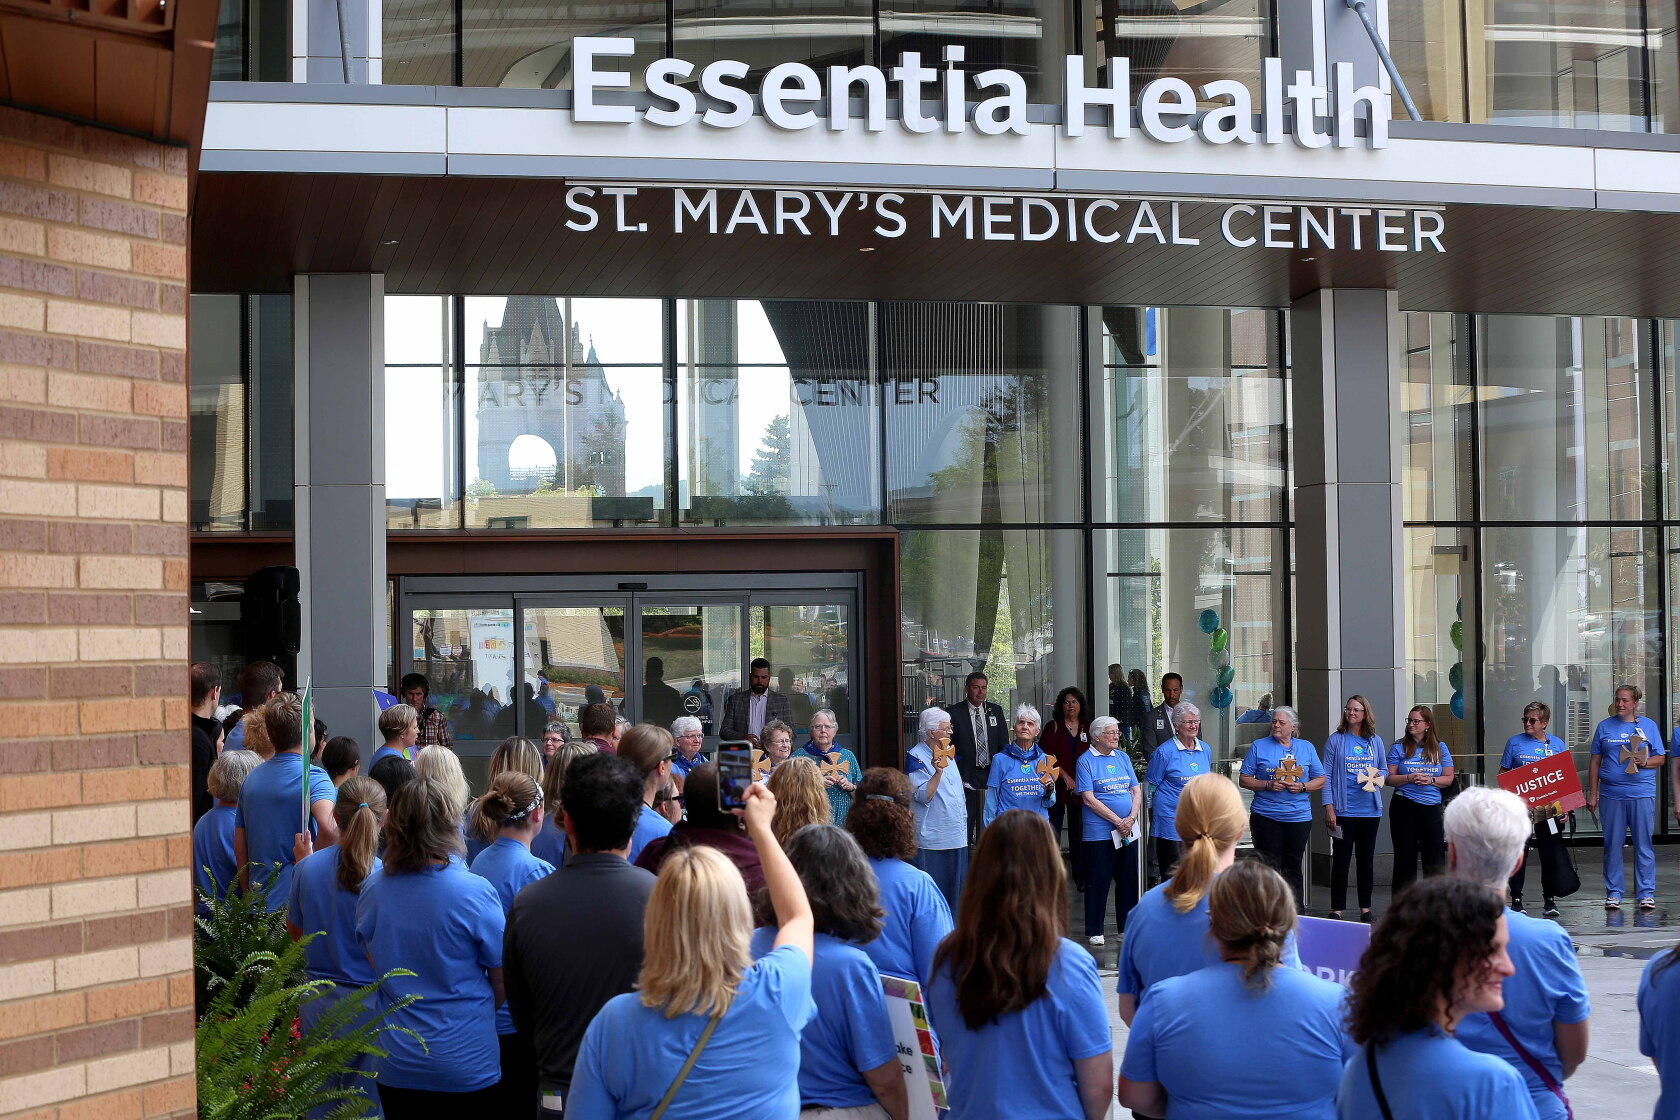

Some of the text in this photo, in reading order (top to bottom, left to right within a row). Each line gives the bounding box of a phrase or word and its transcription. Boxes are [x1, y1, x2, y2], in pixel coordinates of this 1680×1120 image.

[572, 36, 1389, 150] Essentia Health
[564, 186, 1446, 254] ST. MARY’S MEDICAL CENTER
[1515, 769, 1565, 796] JUSTICE
